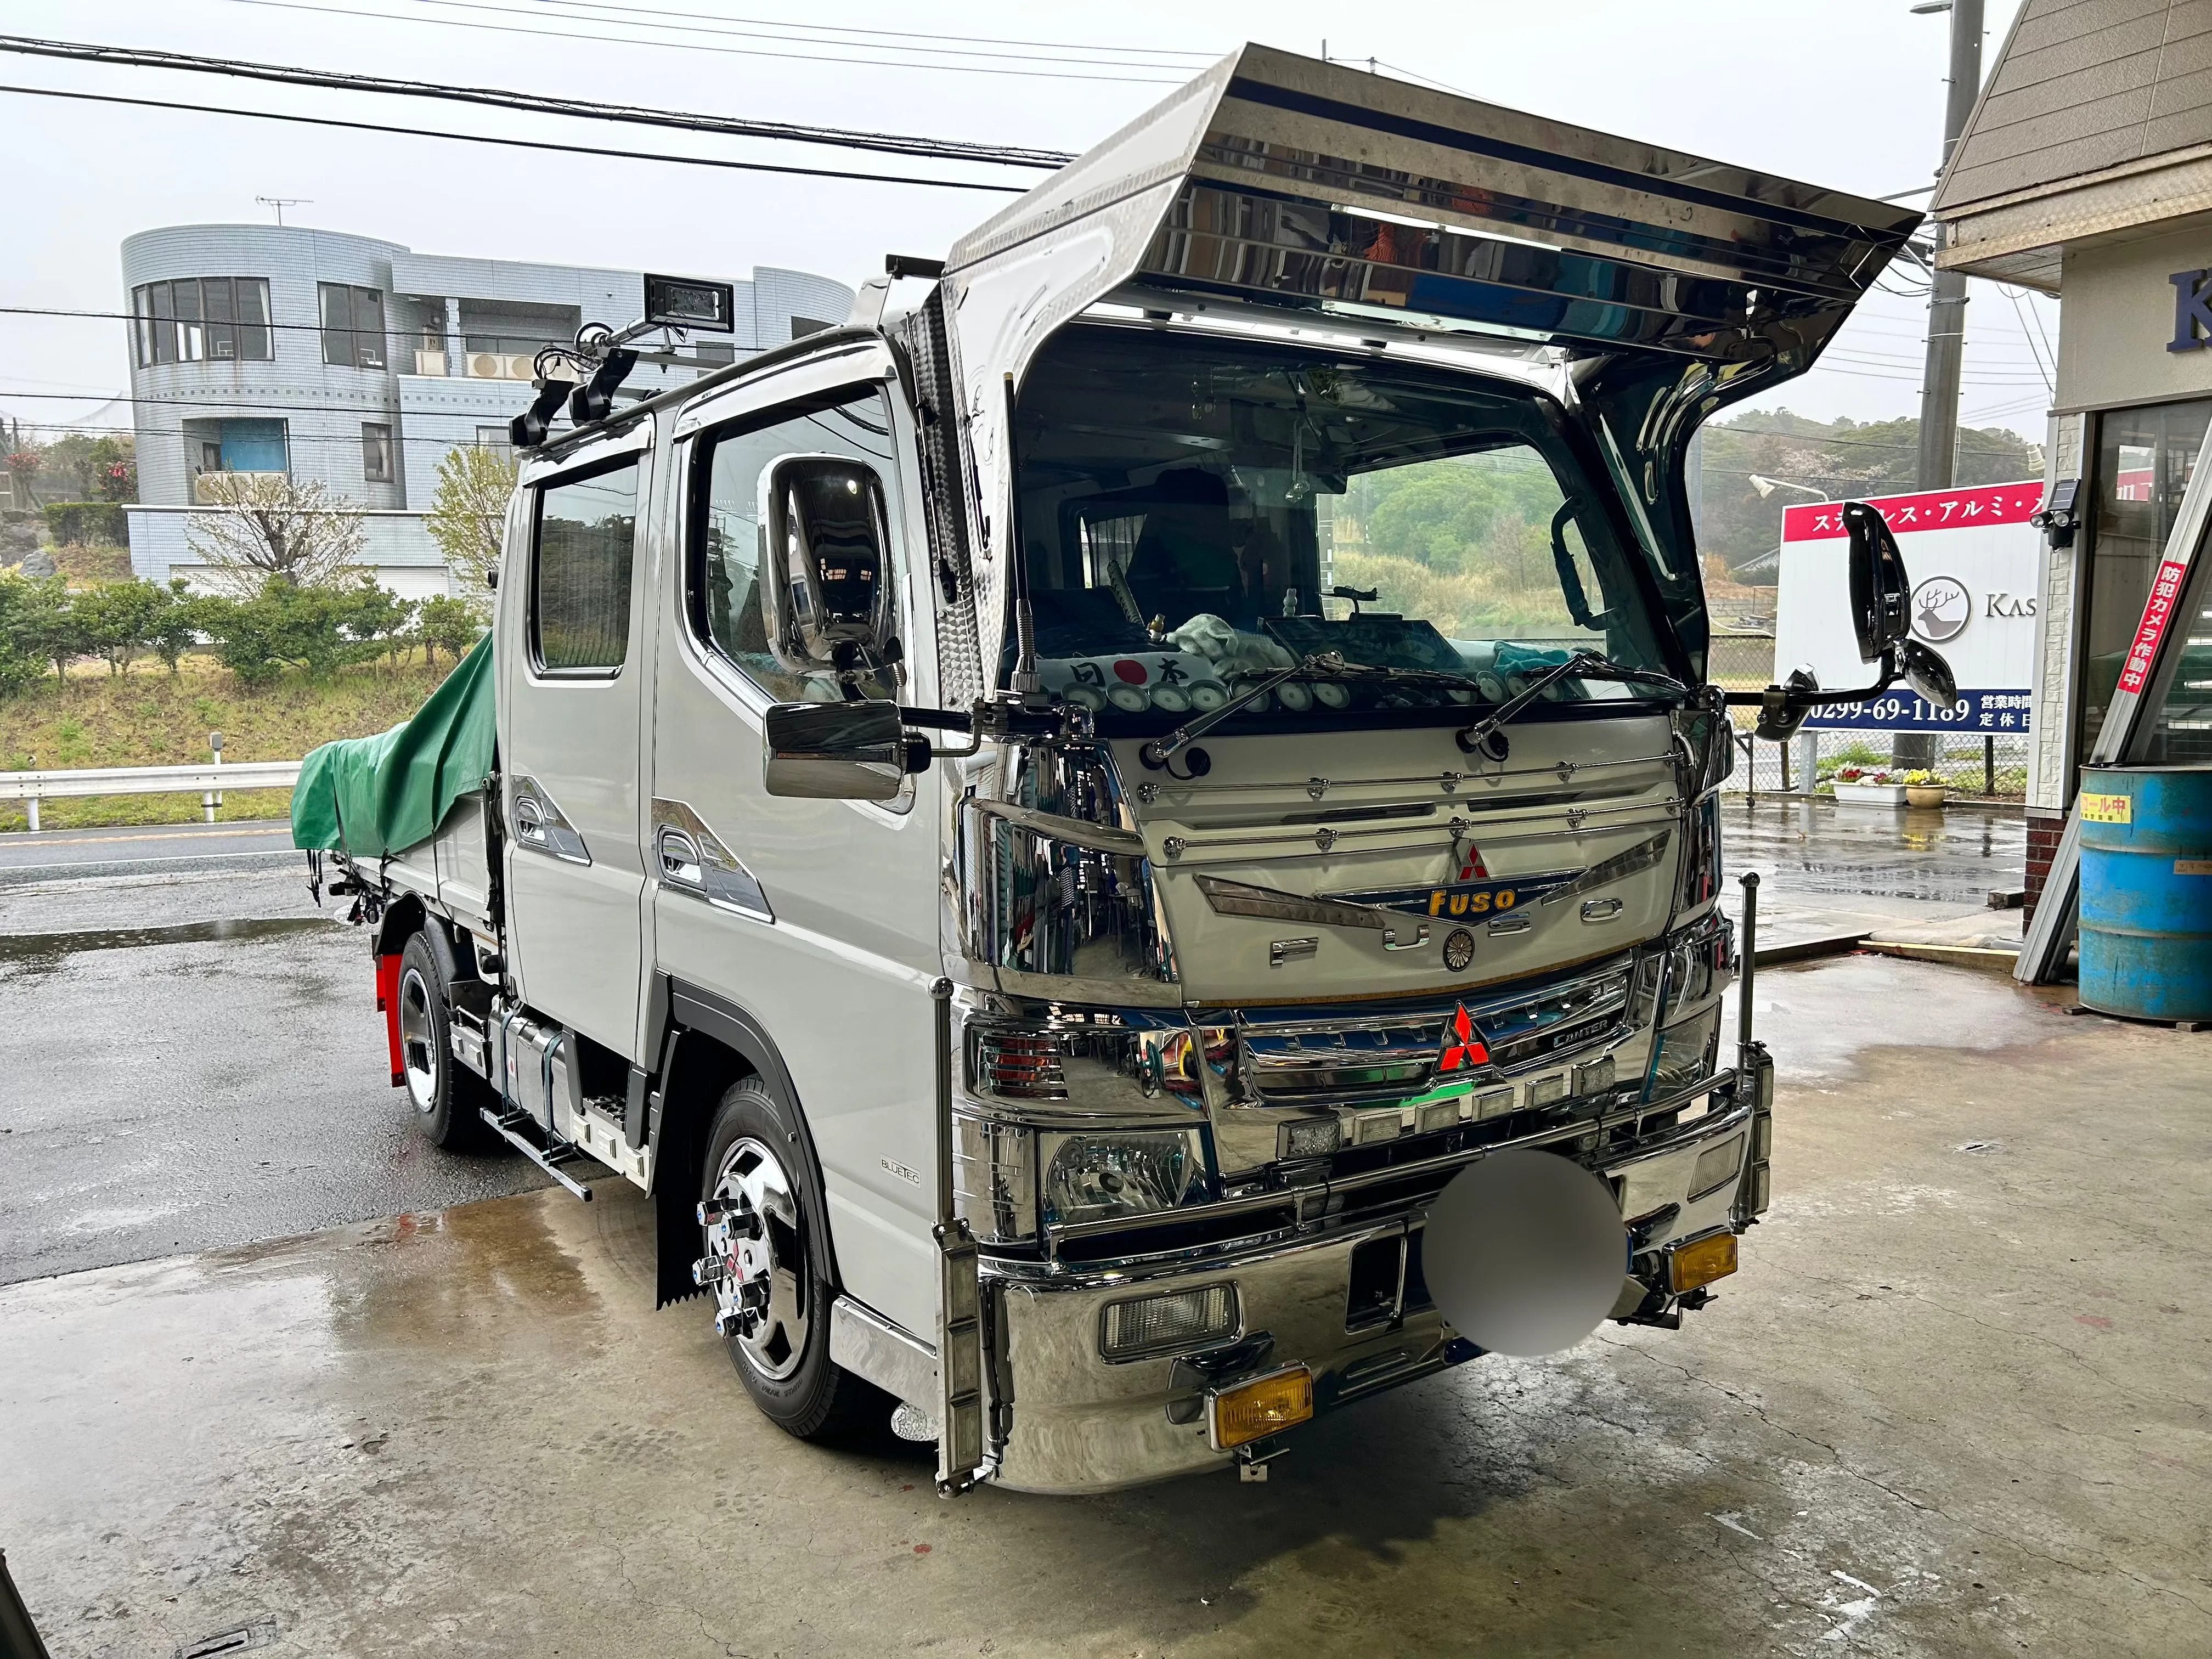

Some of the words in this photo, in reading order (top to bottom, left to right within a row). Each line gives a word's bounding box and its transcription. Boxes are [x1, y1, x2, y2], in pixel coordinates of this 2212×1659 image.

[2123, 566, 2181, 687] 防犯カメラ作動中
[1980, 695, 2032, 709] 営業時間
[1429, 889, 1516, 917] FUSO
[1553, 1019, 1608, 1048] CANTER
